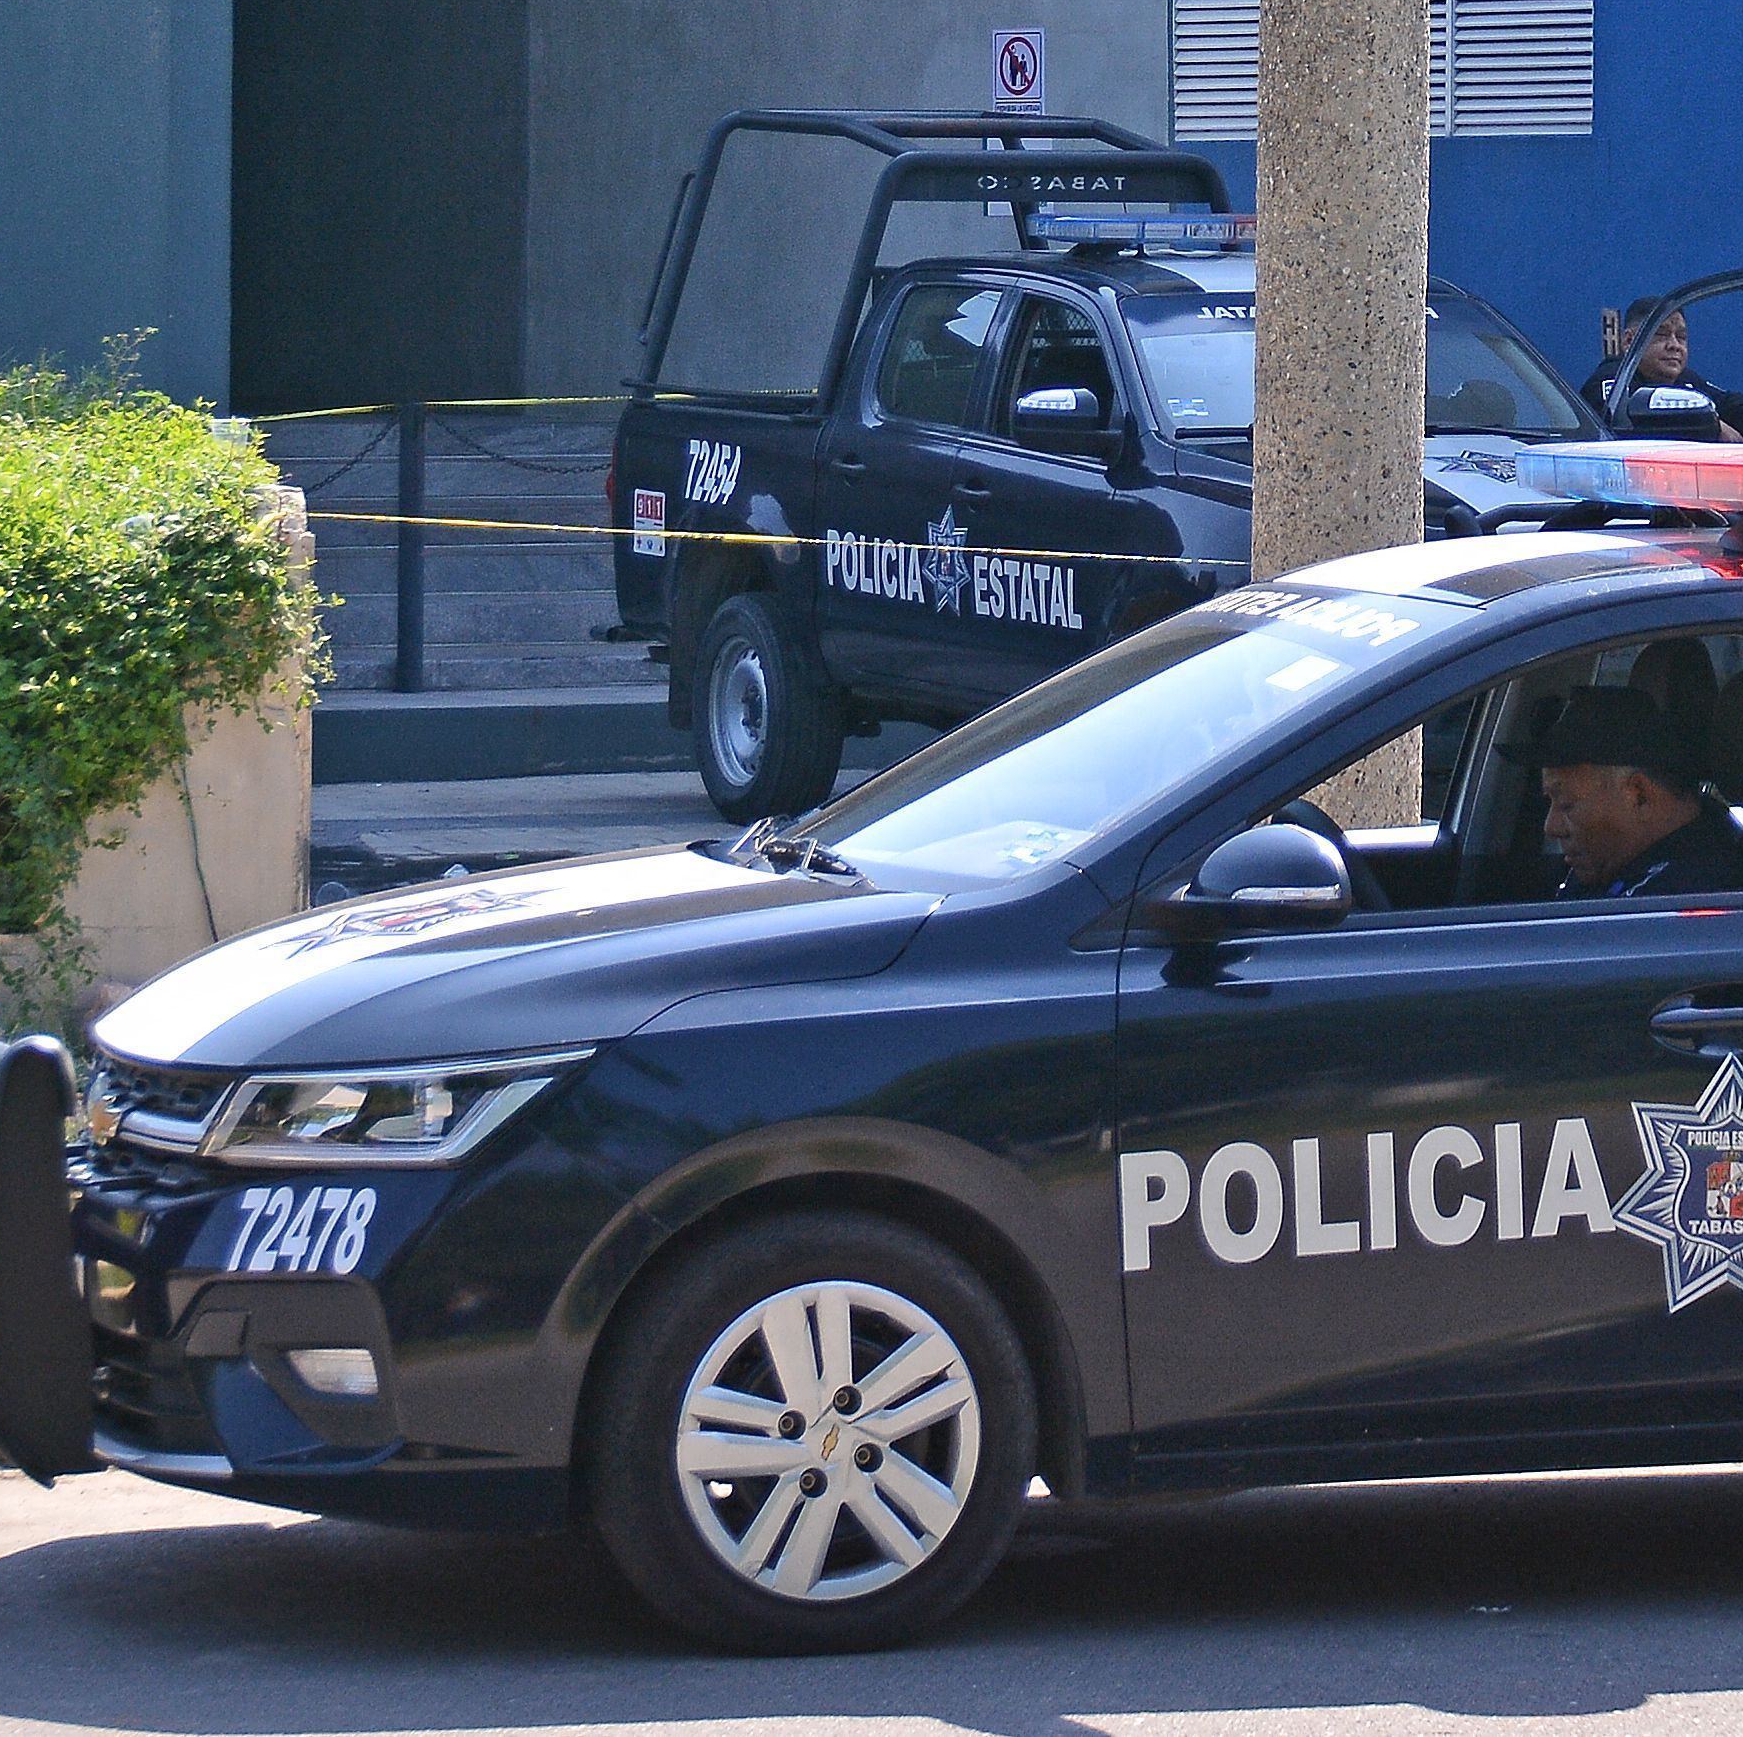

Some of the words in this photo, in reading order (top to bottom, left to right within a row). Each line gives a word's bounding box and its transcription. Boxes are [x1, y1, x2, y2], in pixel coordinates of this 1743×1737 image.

[638, 499, 661, 517] 911
[684, 439, 741, 505] 72454
[826, 529, 925, 604] POLICIA
[973, 555, 1083, 630] ESTATAL
[1687, 1130, 1730, 1146] POLICIA
[226, 1186, 377, 1275] 72478
[1119, 1111, 1614, 1273] POLICIA
